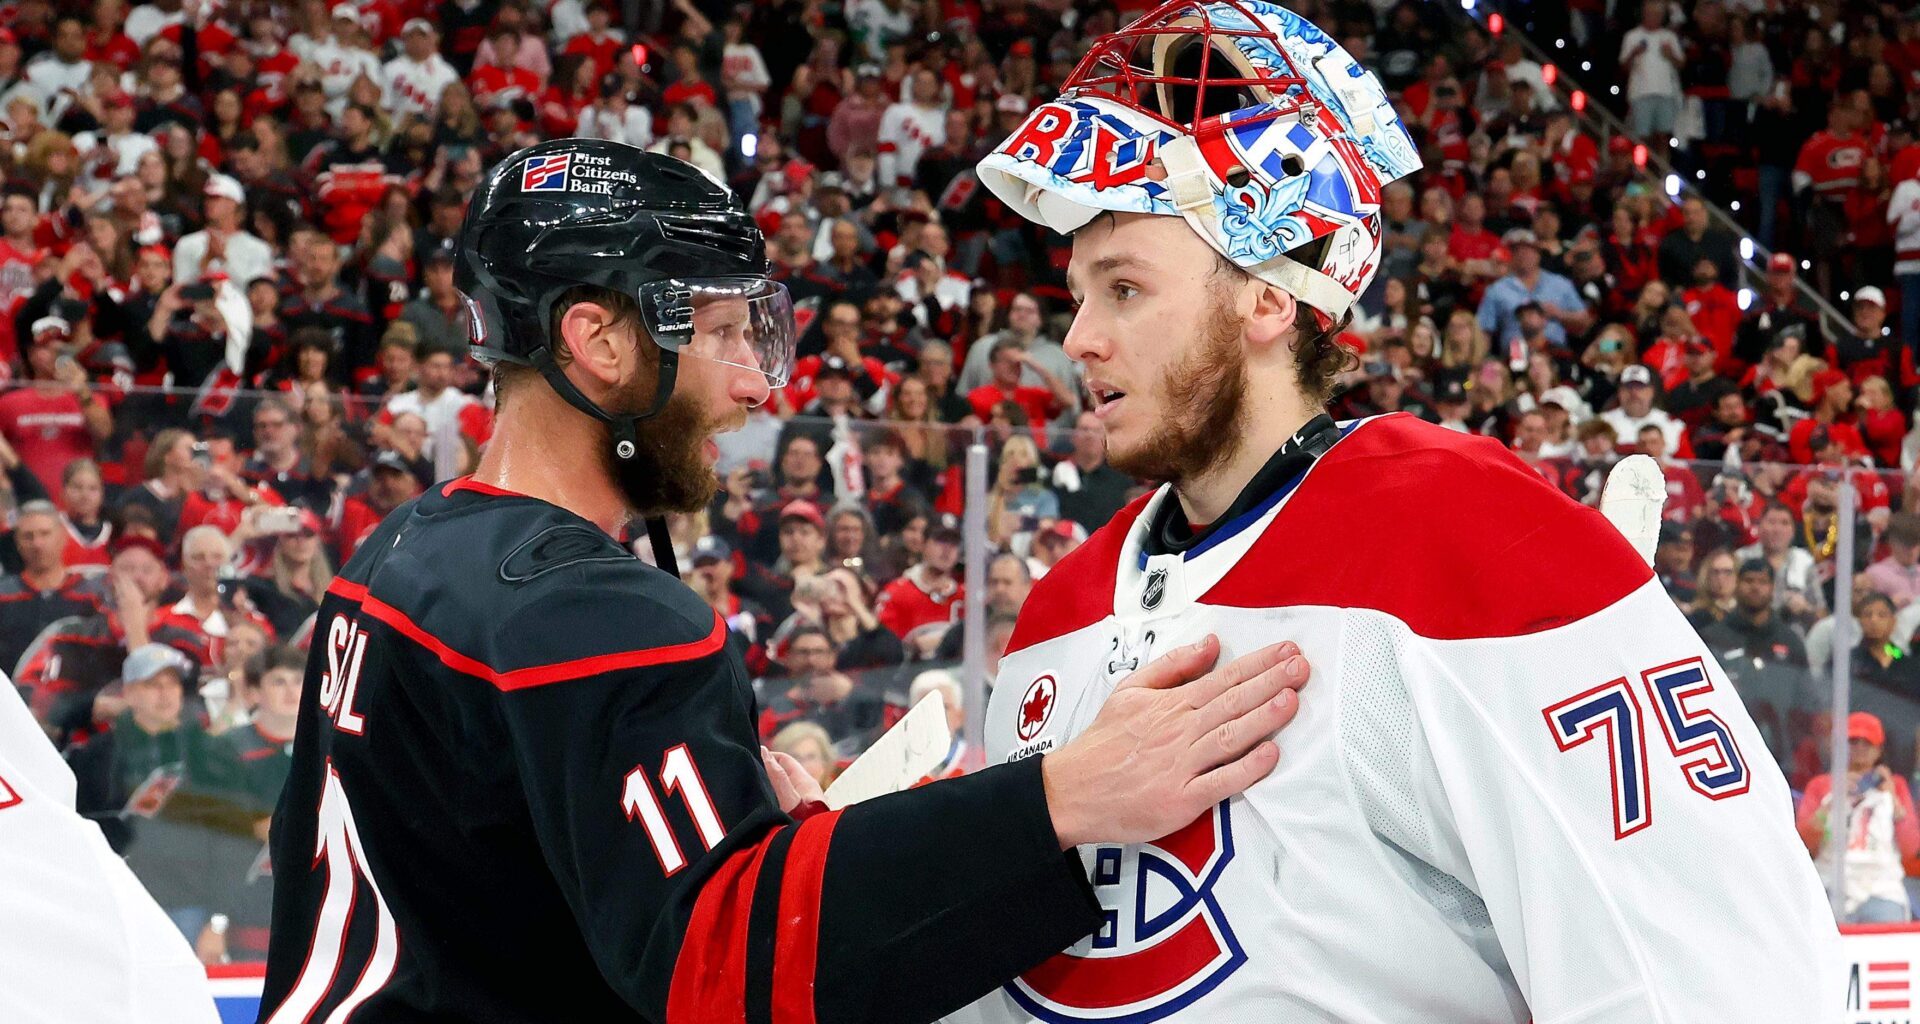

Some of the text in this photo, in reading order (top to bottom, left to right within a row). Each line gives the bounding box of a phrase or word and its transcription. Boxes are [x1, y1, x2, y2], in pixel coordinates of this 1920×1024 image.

[572, 152, 612, 166] First
[571, 165, 637, 184] Citizens
[569, 179, 613, 195] Bank
[1018, 740, 1053, 758] CANADA
[1541, 655, 1751, 841] 75
[619, 742, 728, 878] 11
